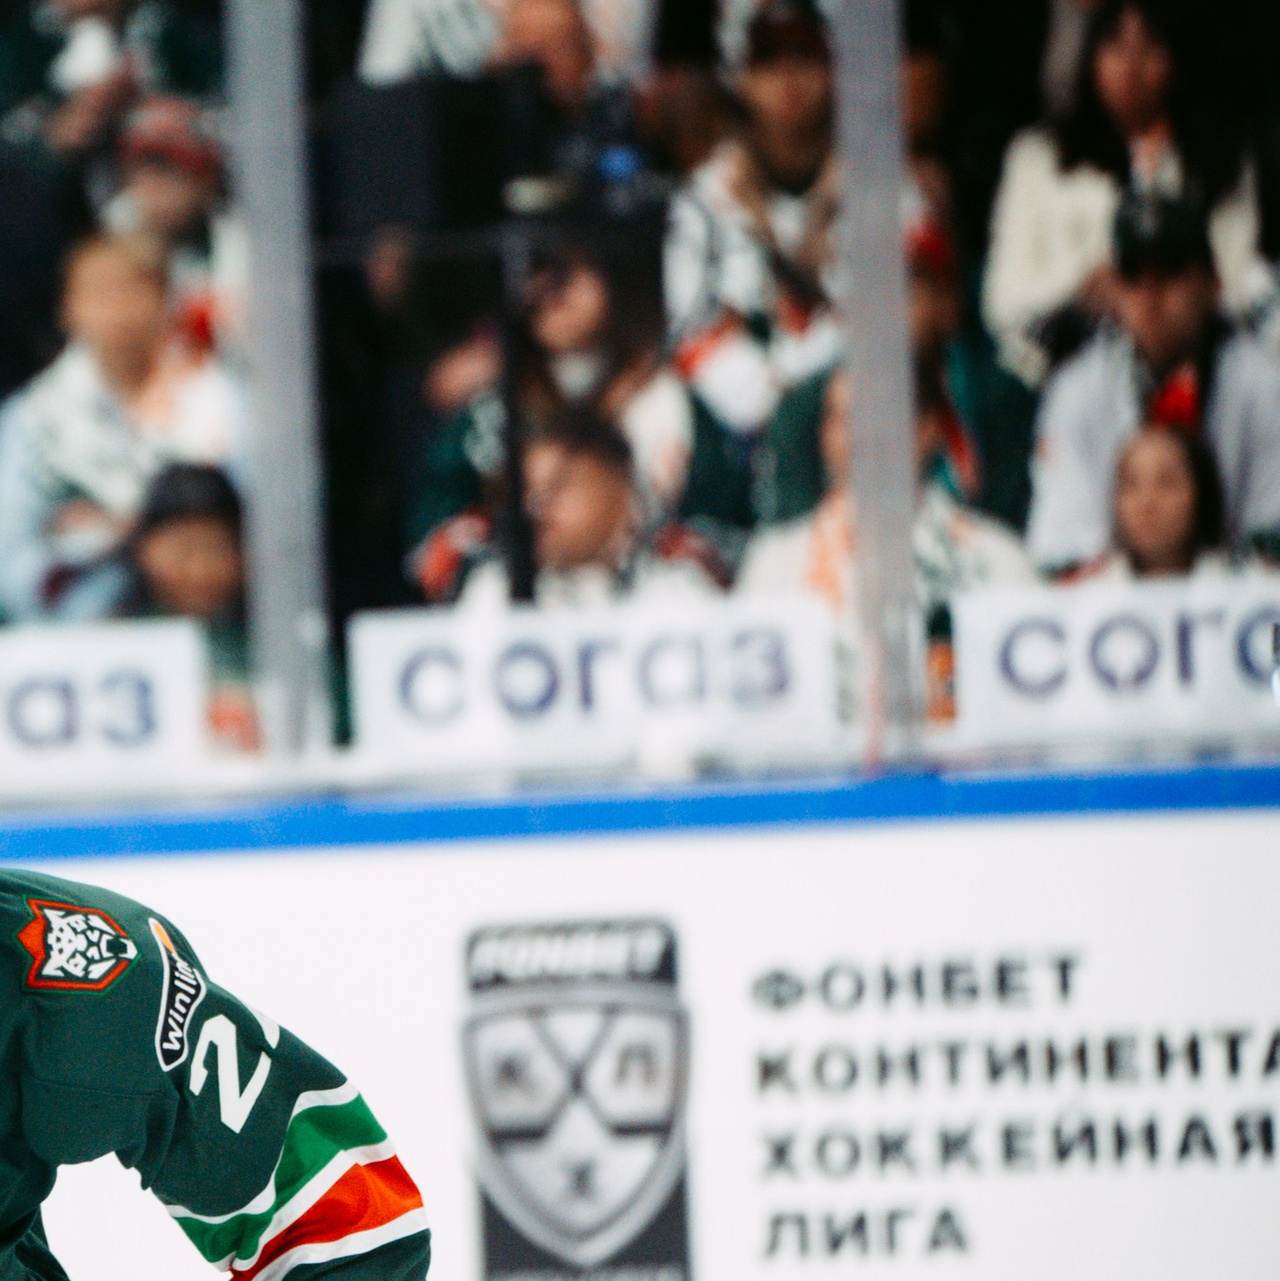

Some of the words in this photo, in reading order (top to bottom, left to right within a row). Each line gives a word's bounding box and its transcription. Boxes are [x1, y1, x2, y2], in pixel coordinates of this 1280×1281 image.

[399, 628, 790, 726] согаз
[752, 955, 1080, 1012] ФОНБЕТ
[189, 1007, 281, 1134] 2
[760, 1096, 1276, 1180] ХОККЕЙНАЯ
[763, 1207, 971, 1259] ЛИГА
